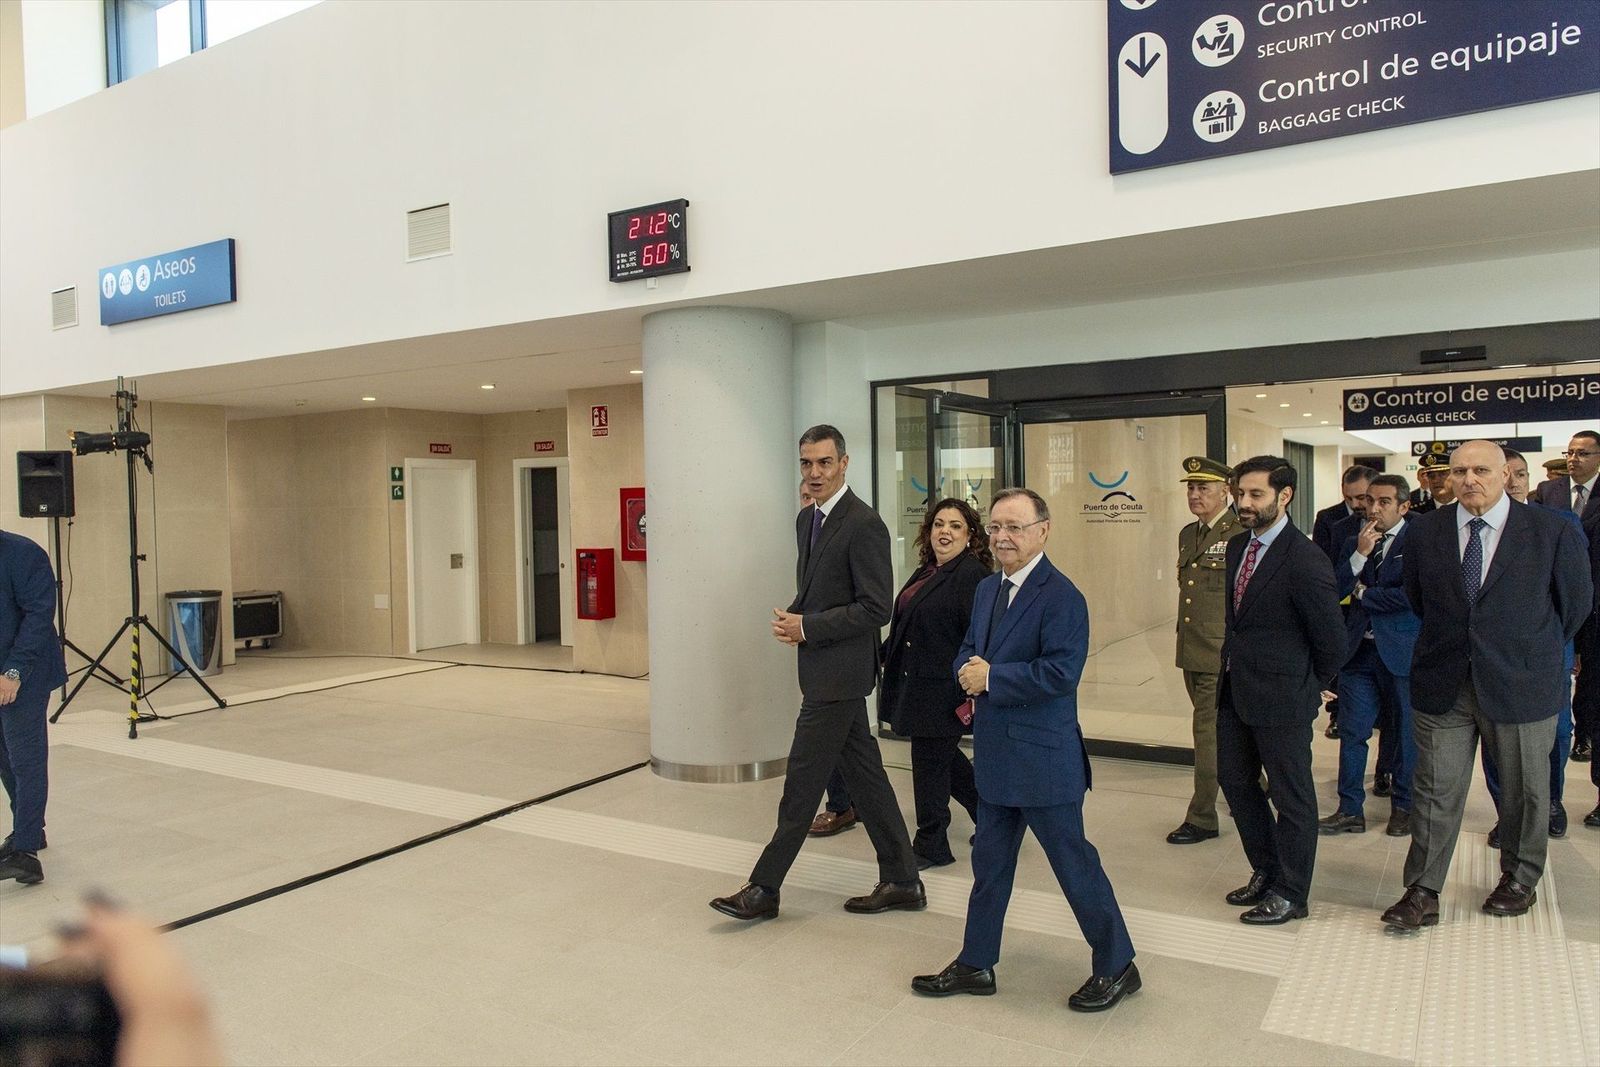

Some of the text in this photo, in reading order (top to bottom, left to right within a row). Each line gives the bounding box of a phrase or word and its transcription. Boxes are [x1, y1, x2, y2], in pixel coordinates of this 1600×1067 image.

[1258, 0, 1368, 26] Contr
[1257, 11, 1427, 58] SECURITY CONTROL
[1258, 22, 1581, 103] Control de equipaje
[1258, 95, 1405, 135] BAGGAGE CHECK
[153, 256, 196, 282] Aseos
[154, 290, 186, 308] TOILETS
[1373, 378, 1600, 407] Control de equipaje
[1373, 411, 1476, 425] BAGGAGE CHECK
[1083, 503, 1108, 511] Puerto
